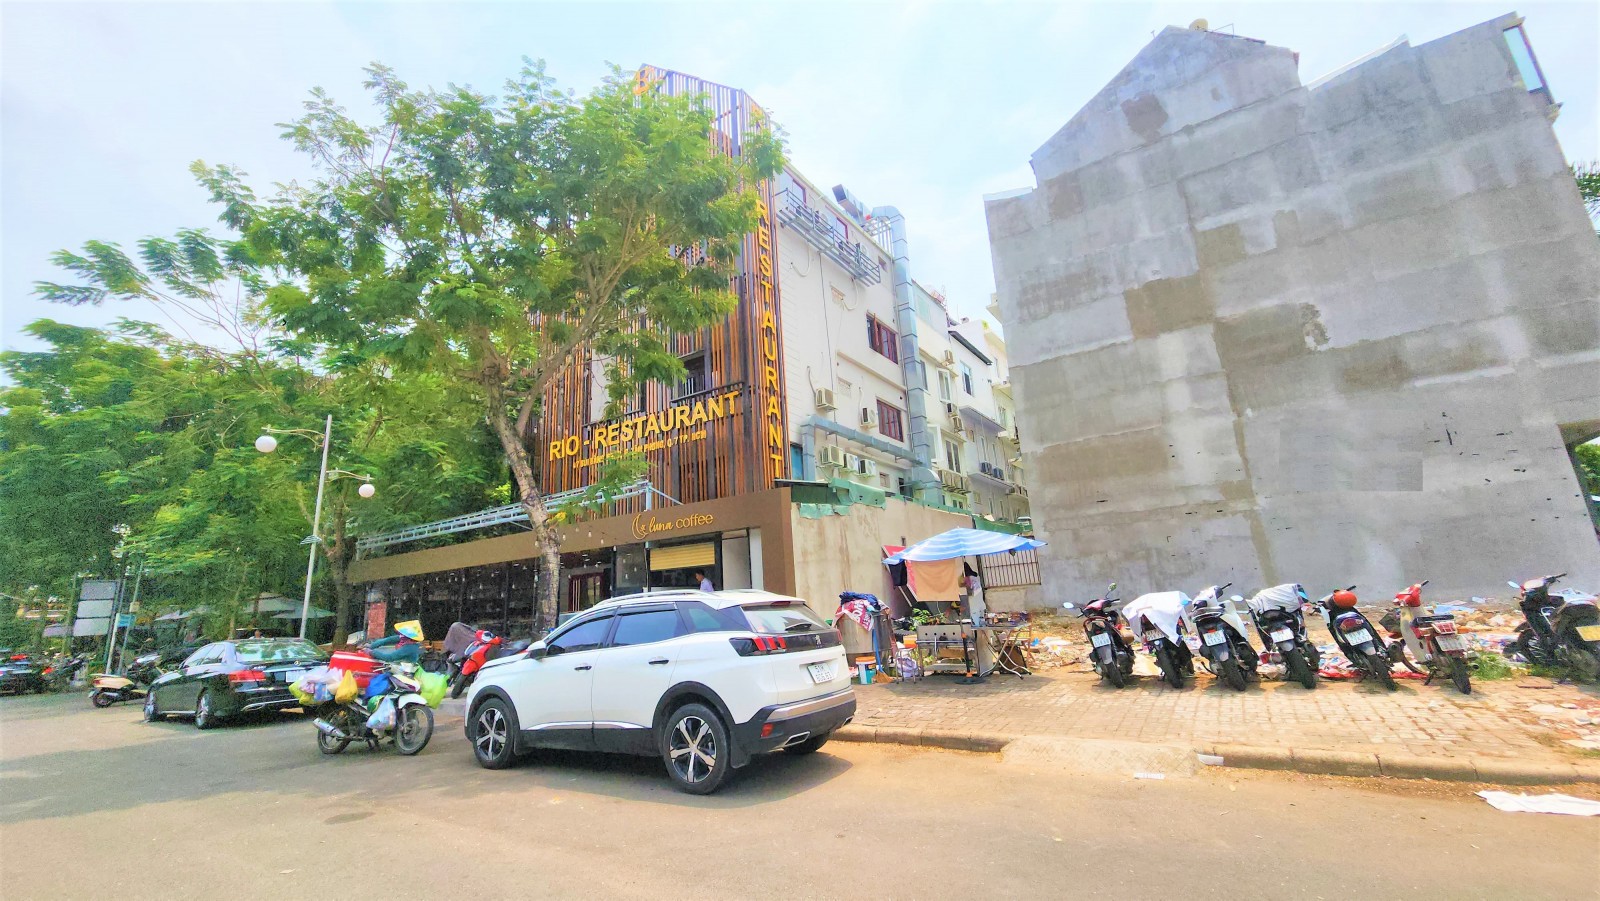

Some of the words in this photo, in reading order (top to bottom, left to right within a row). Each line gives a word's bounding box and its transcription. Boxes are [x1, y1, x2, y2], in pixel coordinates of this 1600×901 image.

[756, 199, 783, 479] RESTAURANT
[549, 435, 580, 461] RIO
[595, 390, 740, 449] RESTAURANT
[649, 516, 674, 533] luna
[675, 513, 714, 529] coffee
